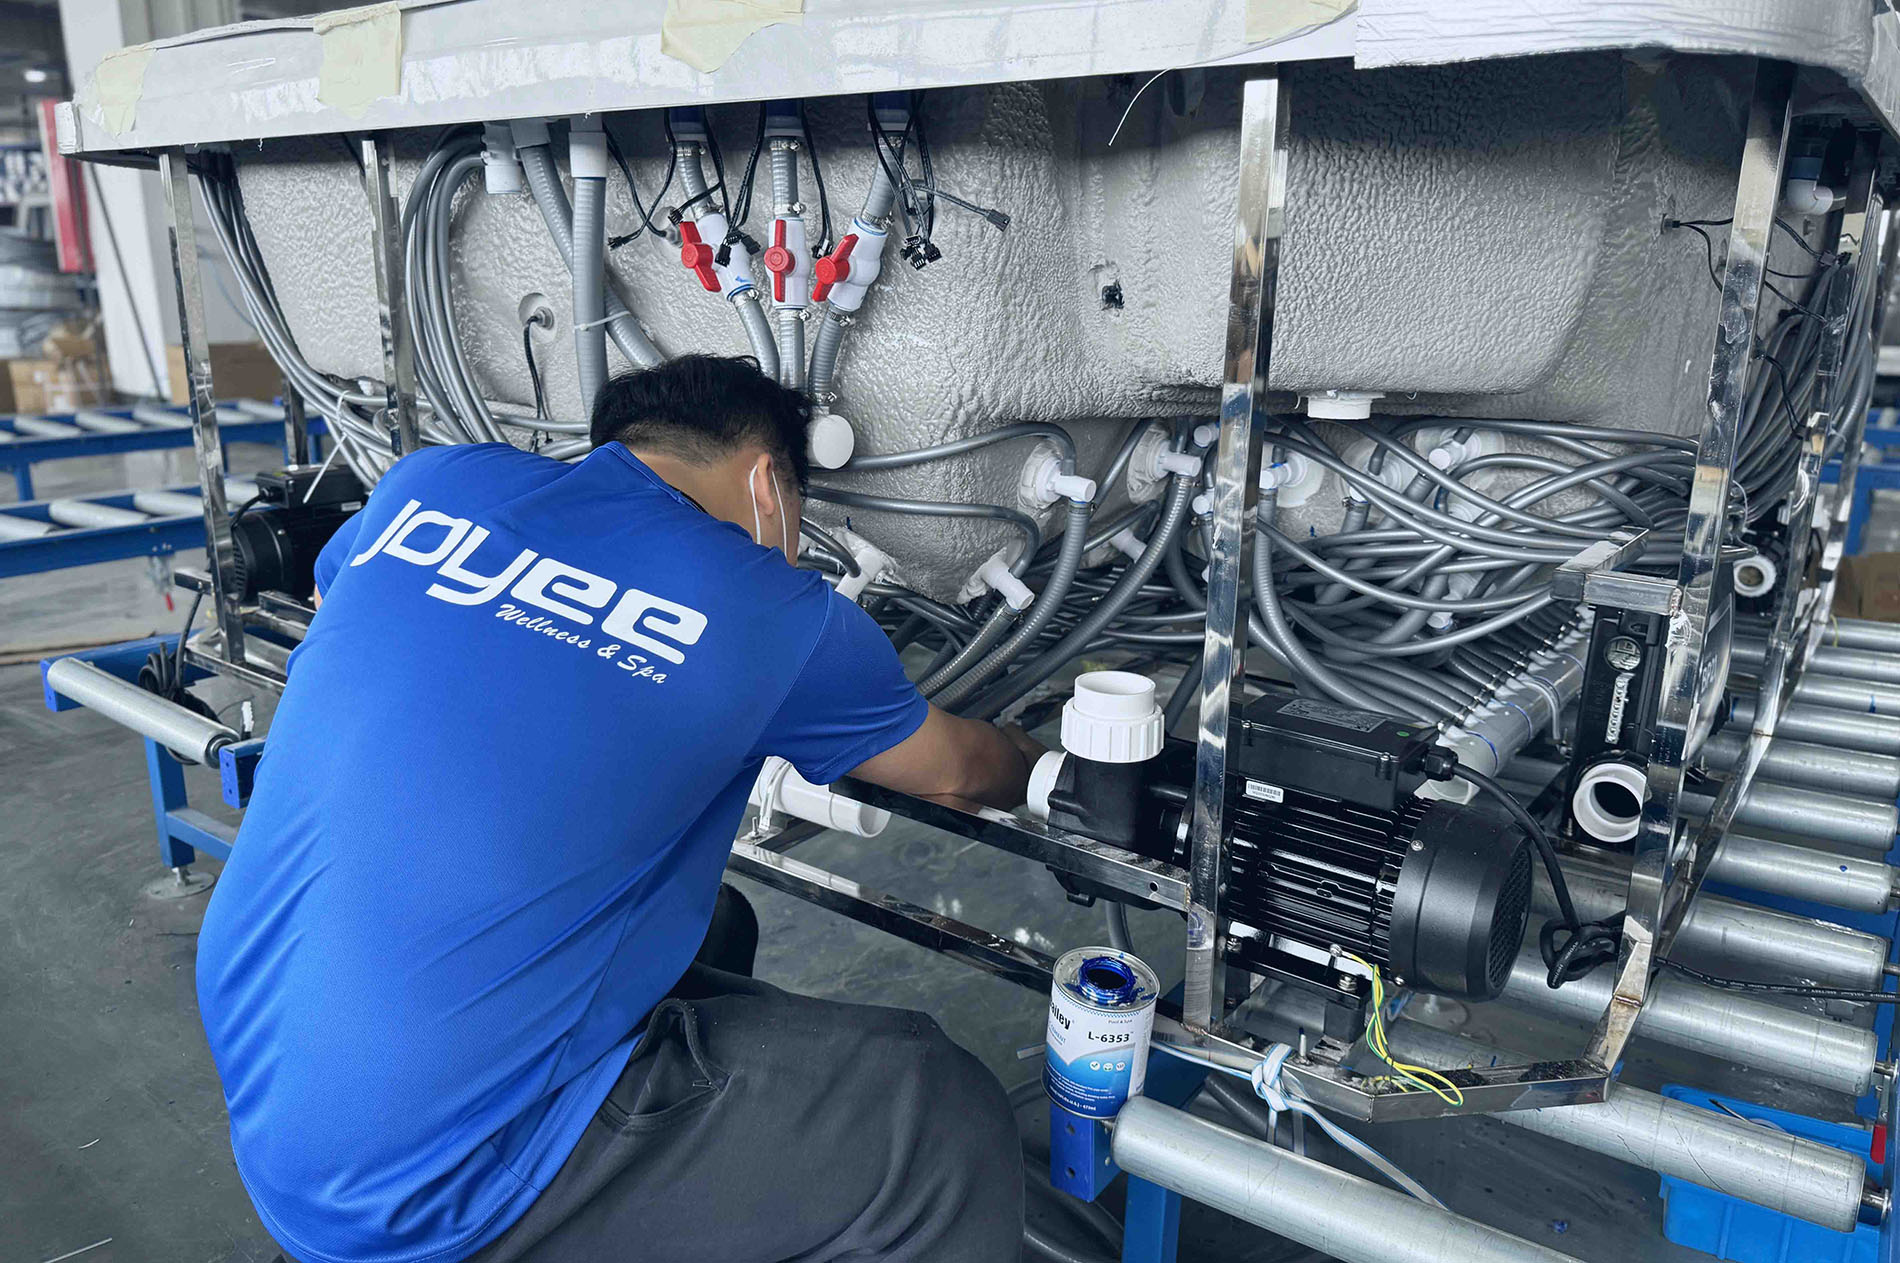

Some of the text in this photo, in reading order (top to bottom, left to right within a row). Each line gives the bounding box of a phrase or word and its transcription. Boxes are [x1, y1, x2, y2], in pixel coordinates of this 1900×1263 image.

[495, 604, 667, 684] Wellness & Spa
[1088, 1031, 1130, 1043] L-6353
